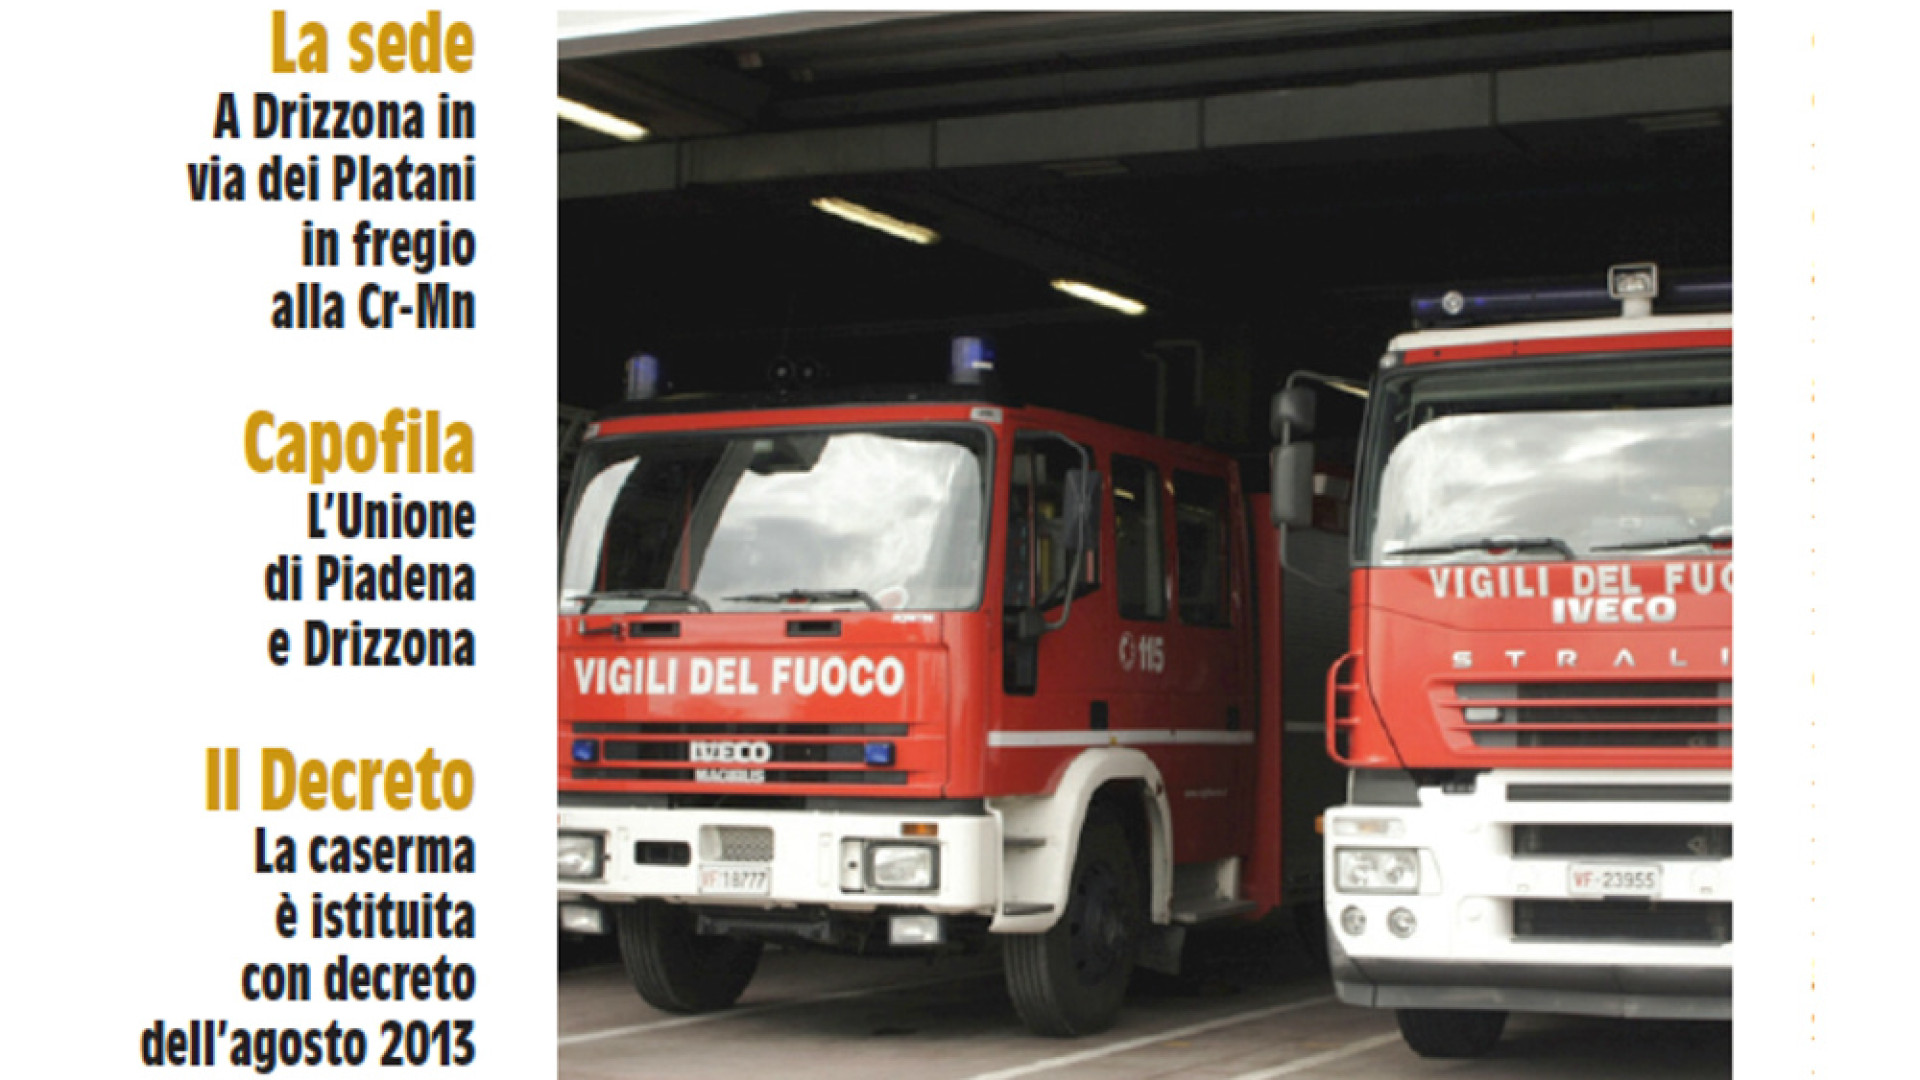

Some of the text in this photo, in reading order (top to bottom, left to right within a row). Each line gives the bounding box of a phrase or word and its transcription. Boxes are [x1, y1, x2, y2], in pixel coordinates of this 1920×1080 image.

[272, 10, 474, 73] La sede
[213, 92, 476, 138] A Drizzona in
[186, 155, 476, 201] via dei Platani
[302, 220, 476, 274] in fregio
[271, 282, 476, 328] alla Cr-Mn
[244, 408, 474, 484] Capofila
[307, 492, 476, 539] L’Unione
[265, 555, 476, 601] di Piadena
[1428, 565, 1549, 598] VIGILI
[1572, 564, 1641, 596] DEL
[1552, 596, 1677, 623] IVECO
[267, 620, 476, 666] e Drizzona
[1139, 634, 1165, 674] 115
[1452, 648, 1729, 669] STRALI
[574, 656, 905, 696] VIGILI DEL FUOCO
[690, 741, 772, 762] IVECO
[206, 748, 474, 810] Il Decreto
[255, 827, 476, 873] La caserma
[276, 892, 476, 938] è istituita
[241, 955, 476, 1001] con decreto
[140, 1020, 476, 1074] dell’agosto 2013
